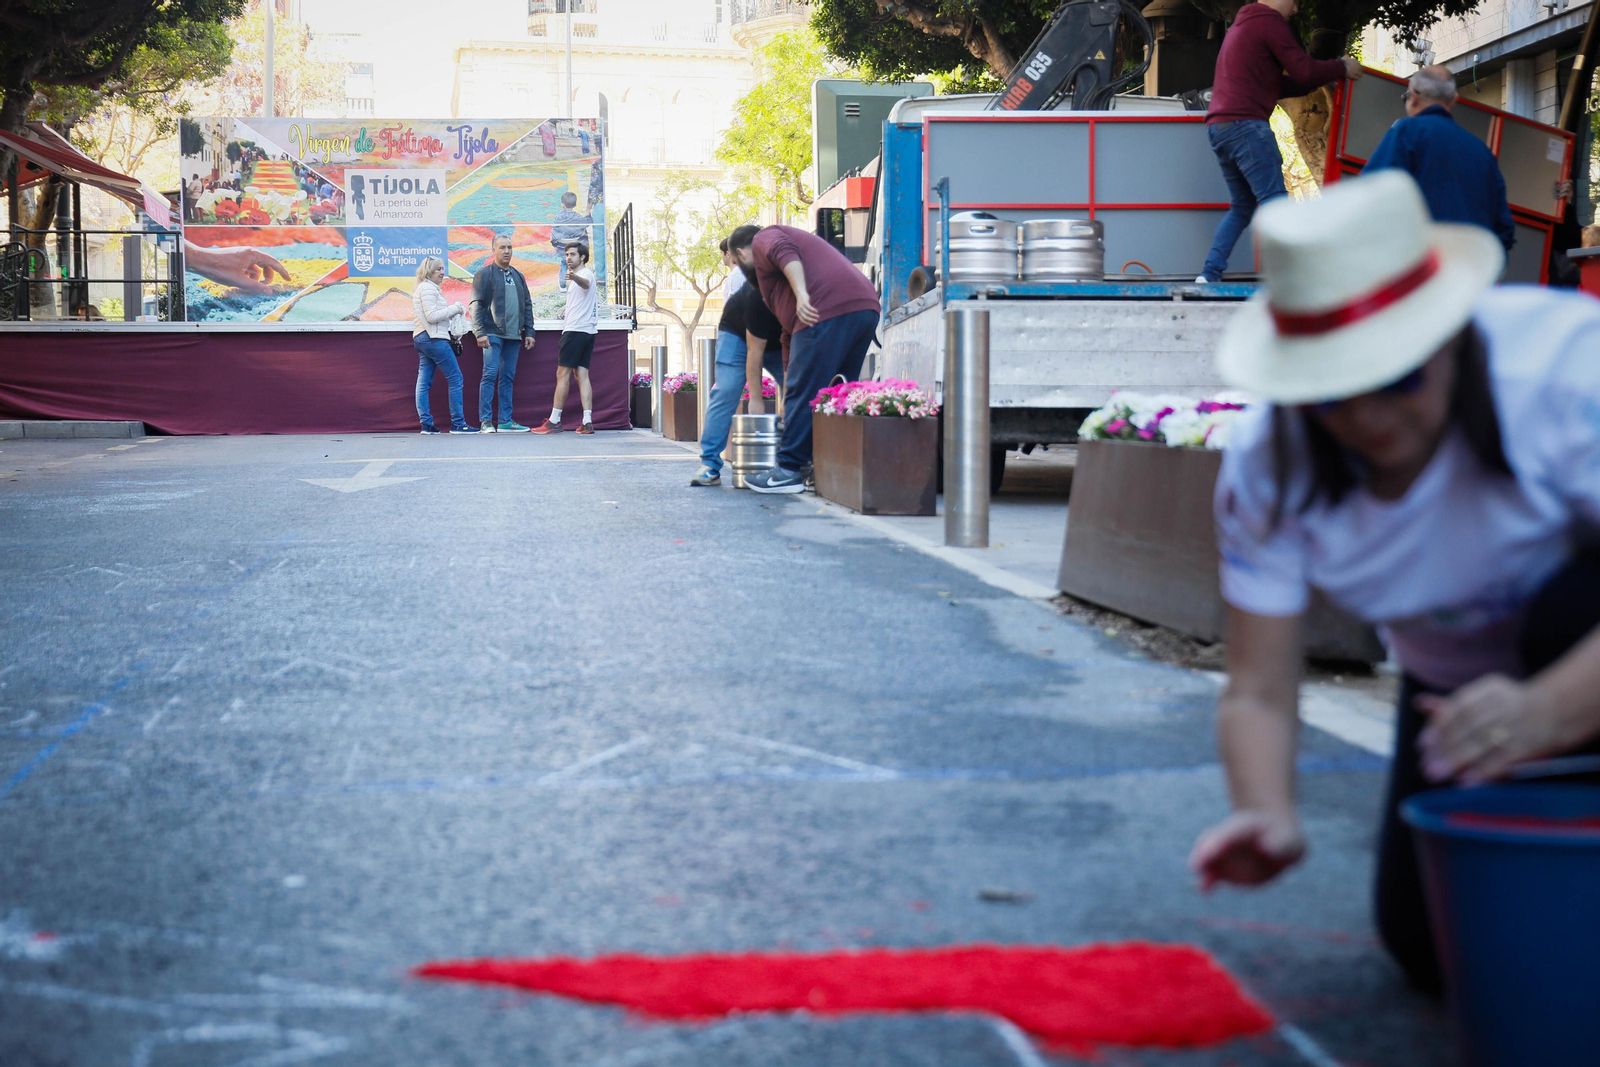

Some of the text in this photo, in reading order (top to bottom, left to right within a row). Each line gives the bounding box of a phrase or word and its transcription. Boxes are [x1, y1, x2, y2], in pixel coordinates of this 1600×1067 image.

[1000, 51, 1053, 110] HIAB 035
[288, 122, 499, 165] Virgen de Fátima Tíjola
[369, 175, 440, 195] TÍJOLA
[373, 198, 428, 209] La perla del
[373, 210, 423, 219] Almanzora
[378, 246, 442, 257] Ayuntamiento
[378, 256, 390, 265] de
